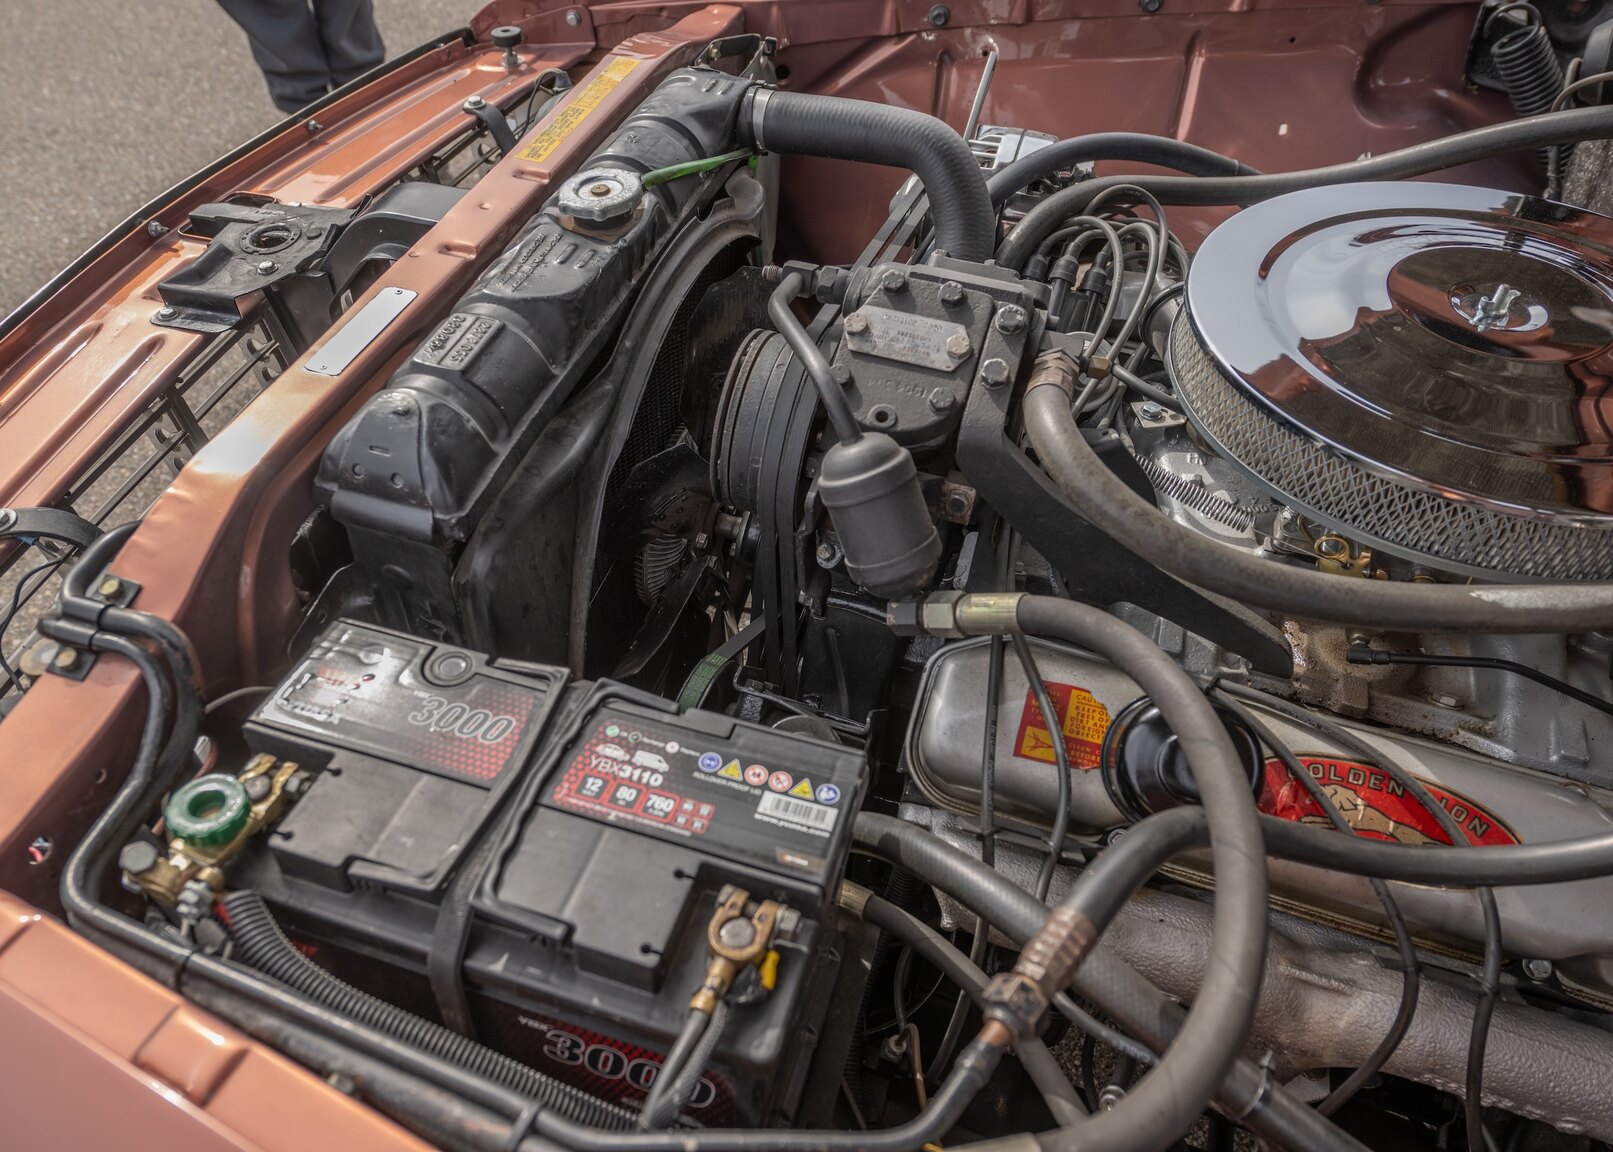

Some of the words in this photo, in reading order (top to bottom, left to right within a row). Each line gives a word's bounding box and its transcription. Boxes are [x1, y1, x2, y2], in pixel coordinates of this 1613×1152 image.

[1076, 705, 1097, 714] KEEP
[1076, 711, 1096, 721] FREE
[408, 696, 517, 744] 3000
[1070, 716, 1090, 726] DIRT
[1068, 742, 1092, 753] CLEAN
[590, 755, 664, 787] YBX3110
[585, 776, 604, 792] 12
[1288, 761, 1407, 798] OLDEN
[646, 793, 675, 813] 760
